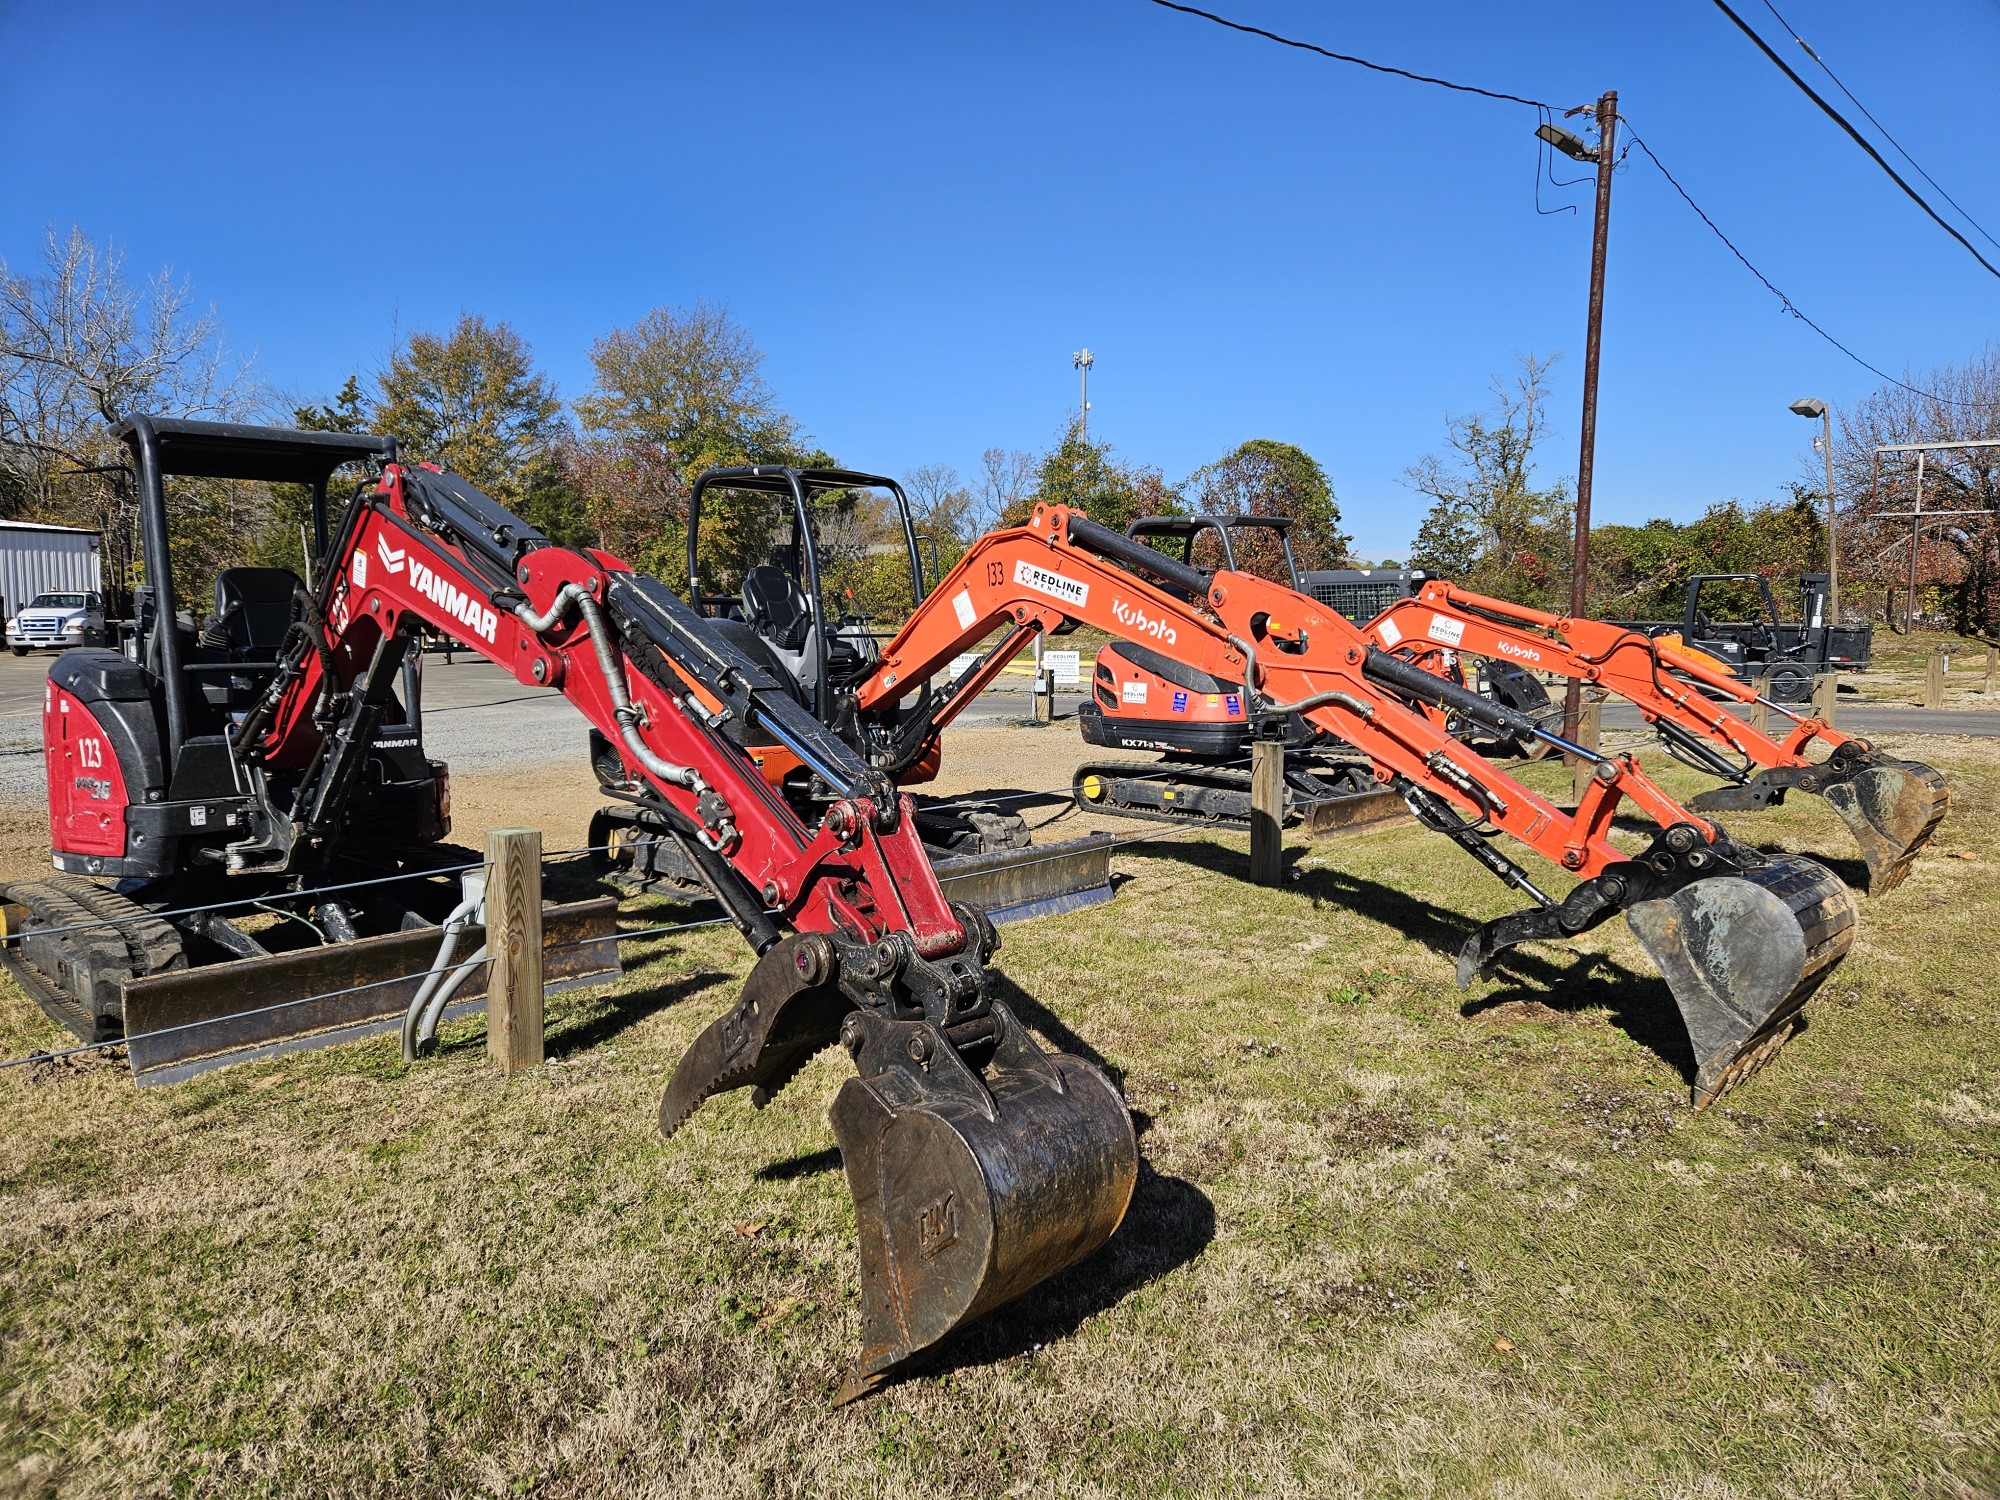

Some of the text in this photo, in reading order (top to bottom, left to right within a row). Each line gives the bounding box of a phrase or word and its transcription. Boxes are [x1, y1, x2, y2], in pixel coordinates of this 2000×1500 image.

[986, 561, 1004, 587] 133
[1033, 571, 1082, 596] REDLINE
[408, 556, 498, 644] YANMAR
[1034, 581, 1079, 601] RENTALS
[1112, 599, 1177, 645] Kubota
[1431, 625, 1460, 638] REDLINE
[1498, 641, 1541, 661] Kubota
[79, 738, 102, 768] 123
